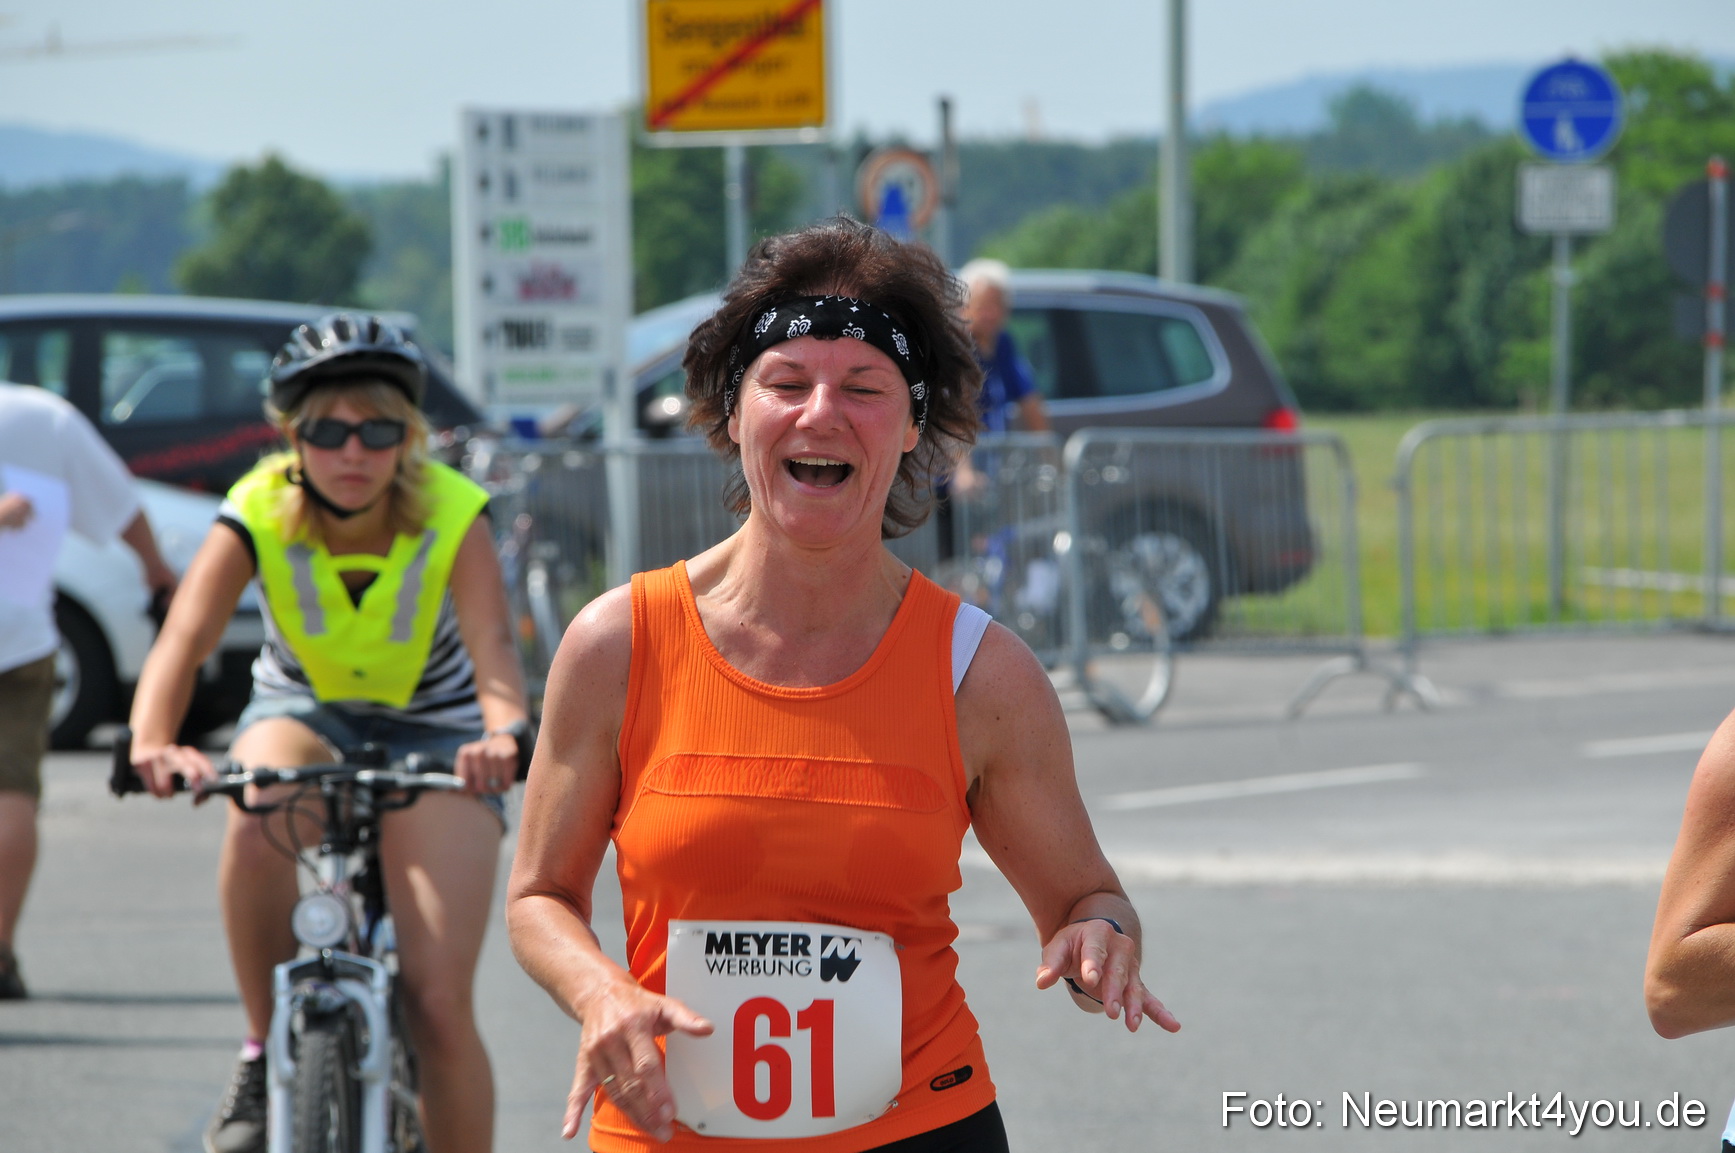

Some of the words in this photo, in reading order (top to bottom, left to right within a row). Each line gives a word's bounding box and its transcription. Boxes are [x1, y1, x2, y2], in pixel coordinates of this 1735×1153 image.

[704, 930, 812, 956] MEYER
[705, 958, 813, 977] WERBUNG
[732, 996, 836, 1121] 61
